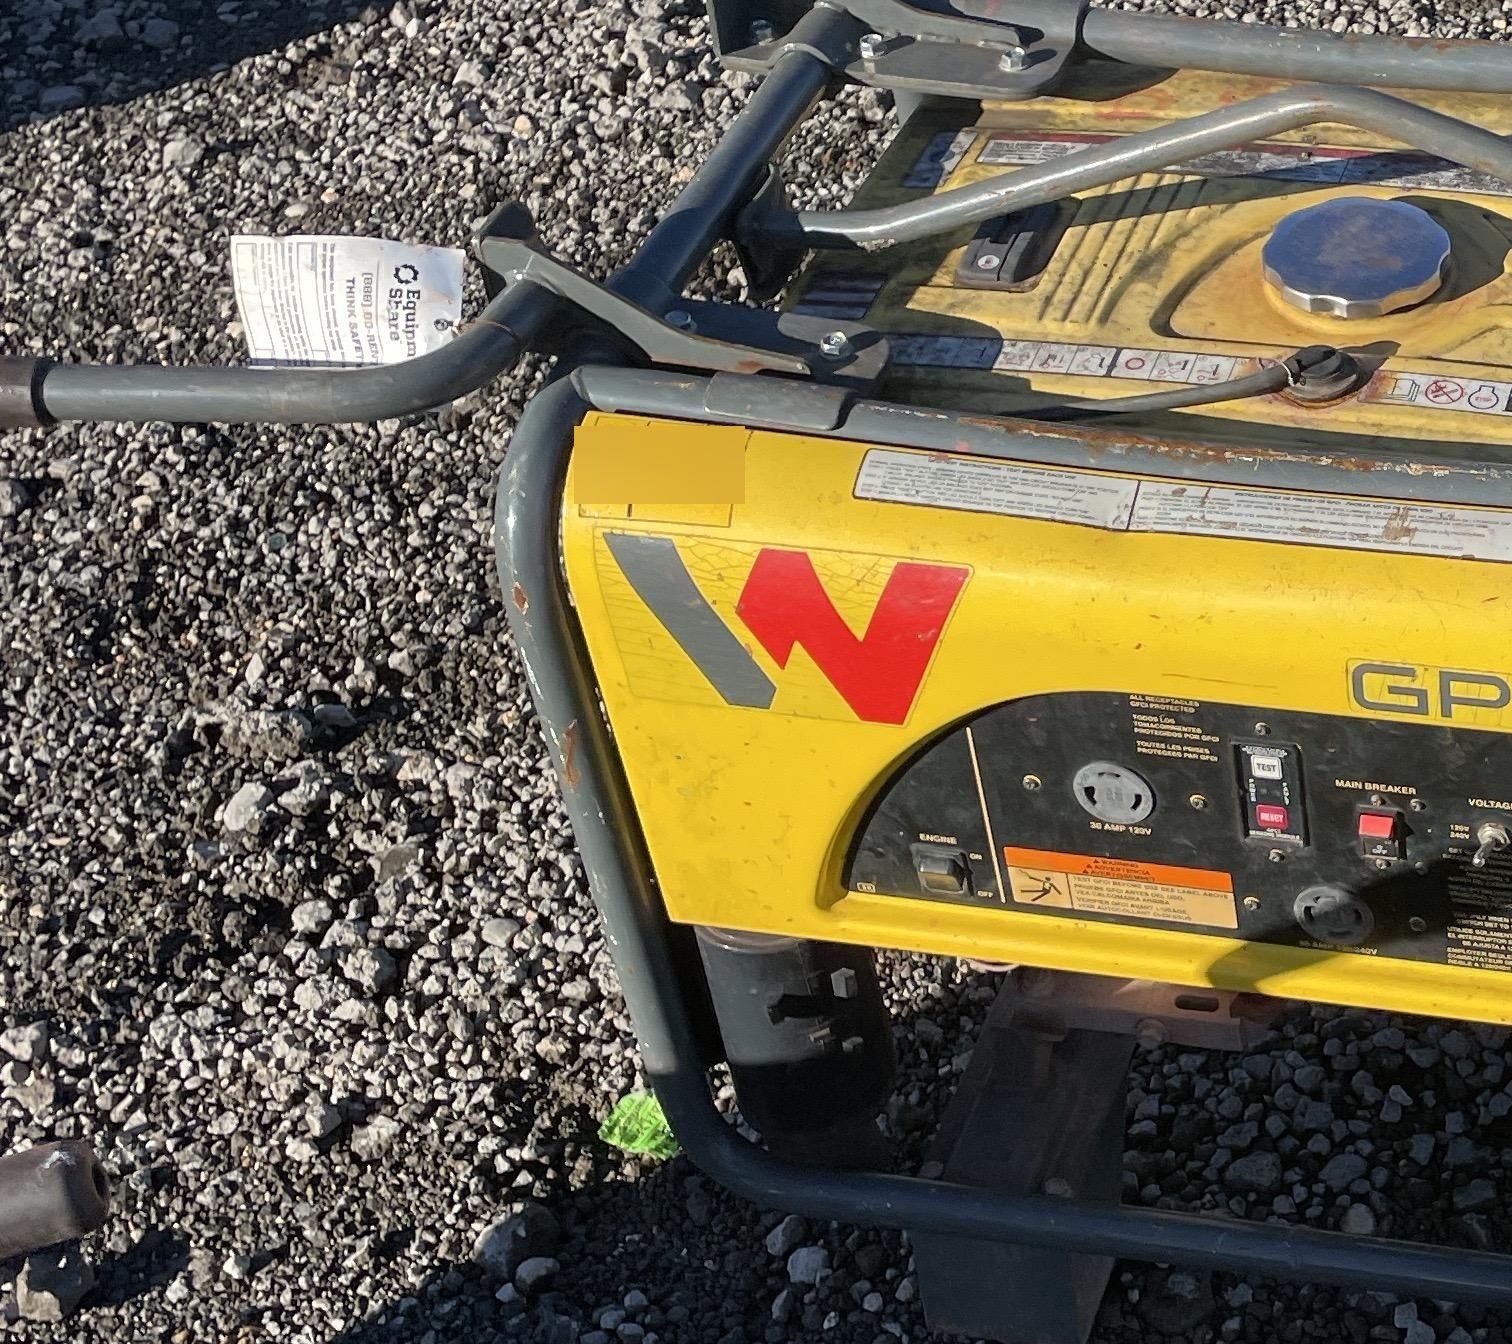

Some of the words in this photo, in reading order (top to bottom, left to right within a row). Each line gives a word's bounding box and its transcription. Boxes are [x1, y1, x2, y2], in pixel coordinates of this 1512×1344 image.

[346, 277, 356, 318] THINK
[403, 289, 421, 357] Equipm
[348, 321, 364, 360] SAFET
[1256, 762, 1276, 772] TEST
[1335, 779, 1363, 790] MAIN
[1364, 782, 1416, 795] BREAKER
[1103, 824, 1126, 833] AMP
[919, 833, 958, 845] ENGINE
